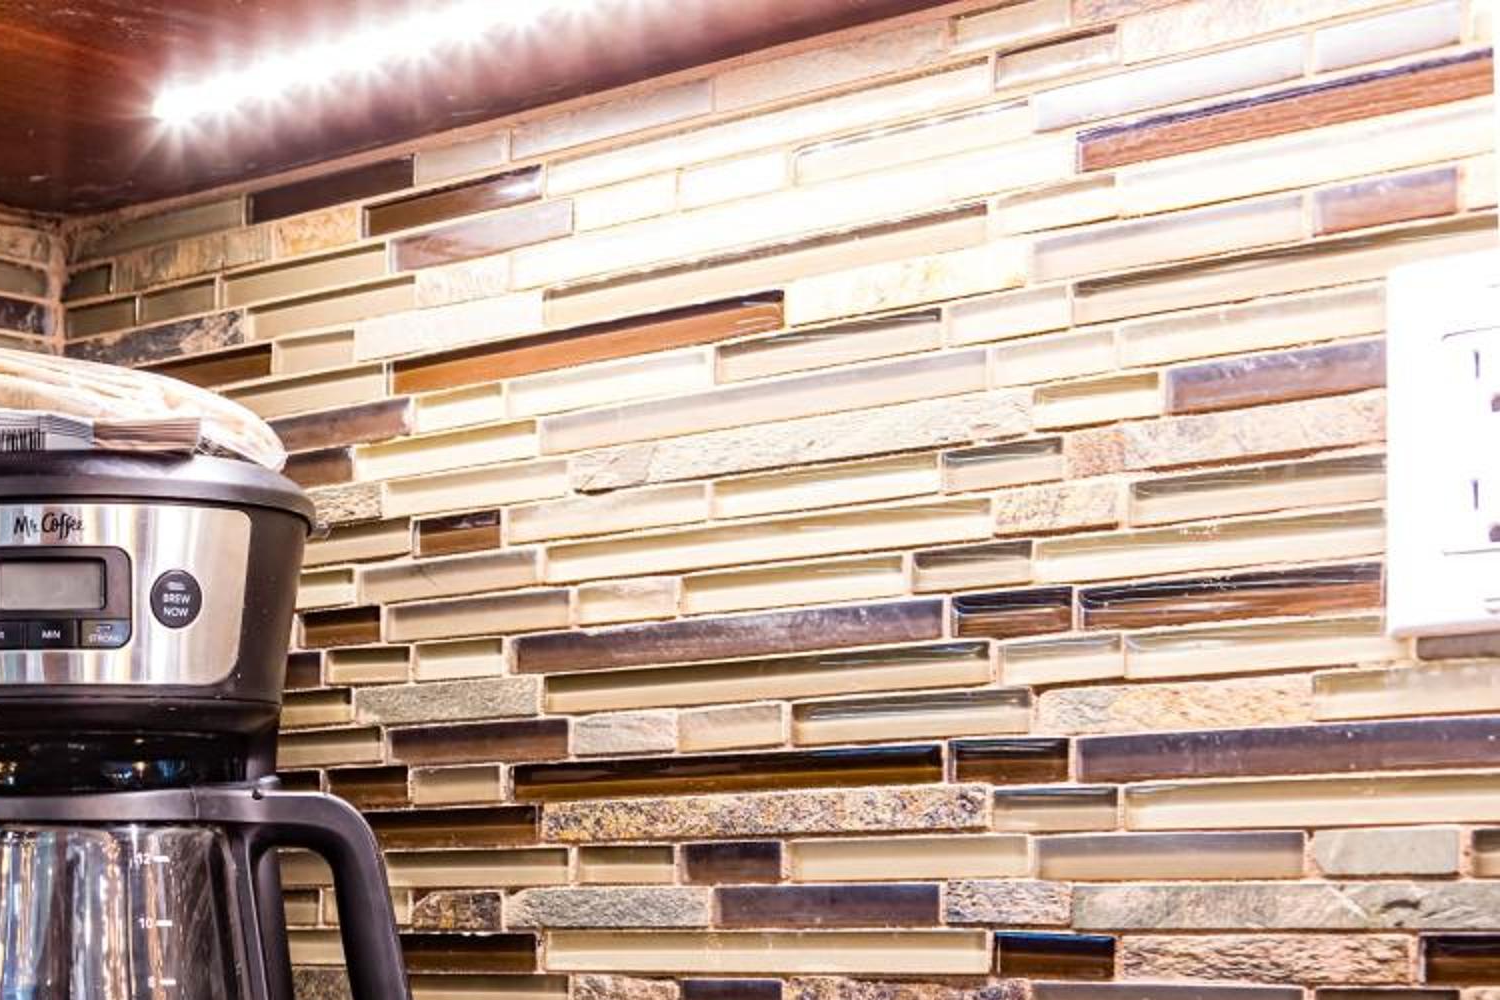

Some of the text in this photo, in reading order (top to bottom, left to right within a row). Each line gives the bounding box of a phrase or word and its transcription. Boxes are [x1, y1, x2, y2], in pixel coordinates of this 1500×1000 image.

[41, 511, 85, 540] Coffee
[162, 593, 190, 604] BREW
[163, 607, 189, 617] NOW
[41, 629, 62, 640] MIN
[136, 852, 151, 865] 12
[139, 917, 154, 929] 10
